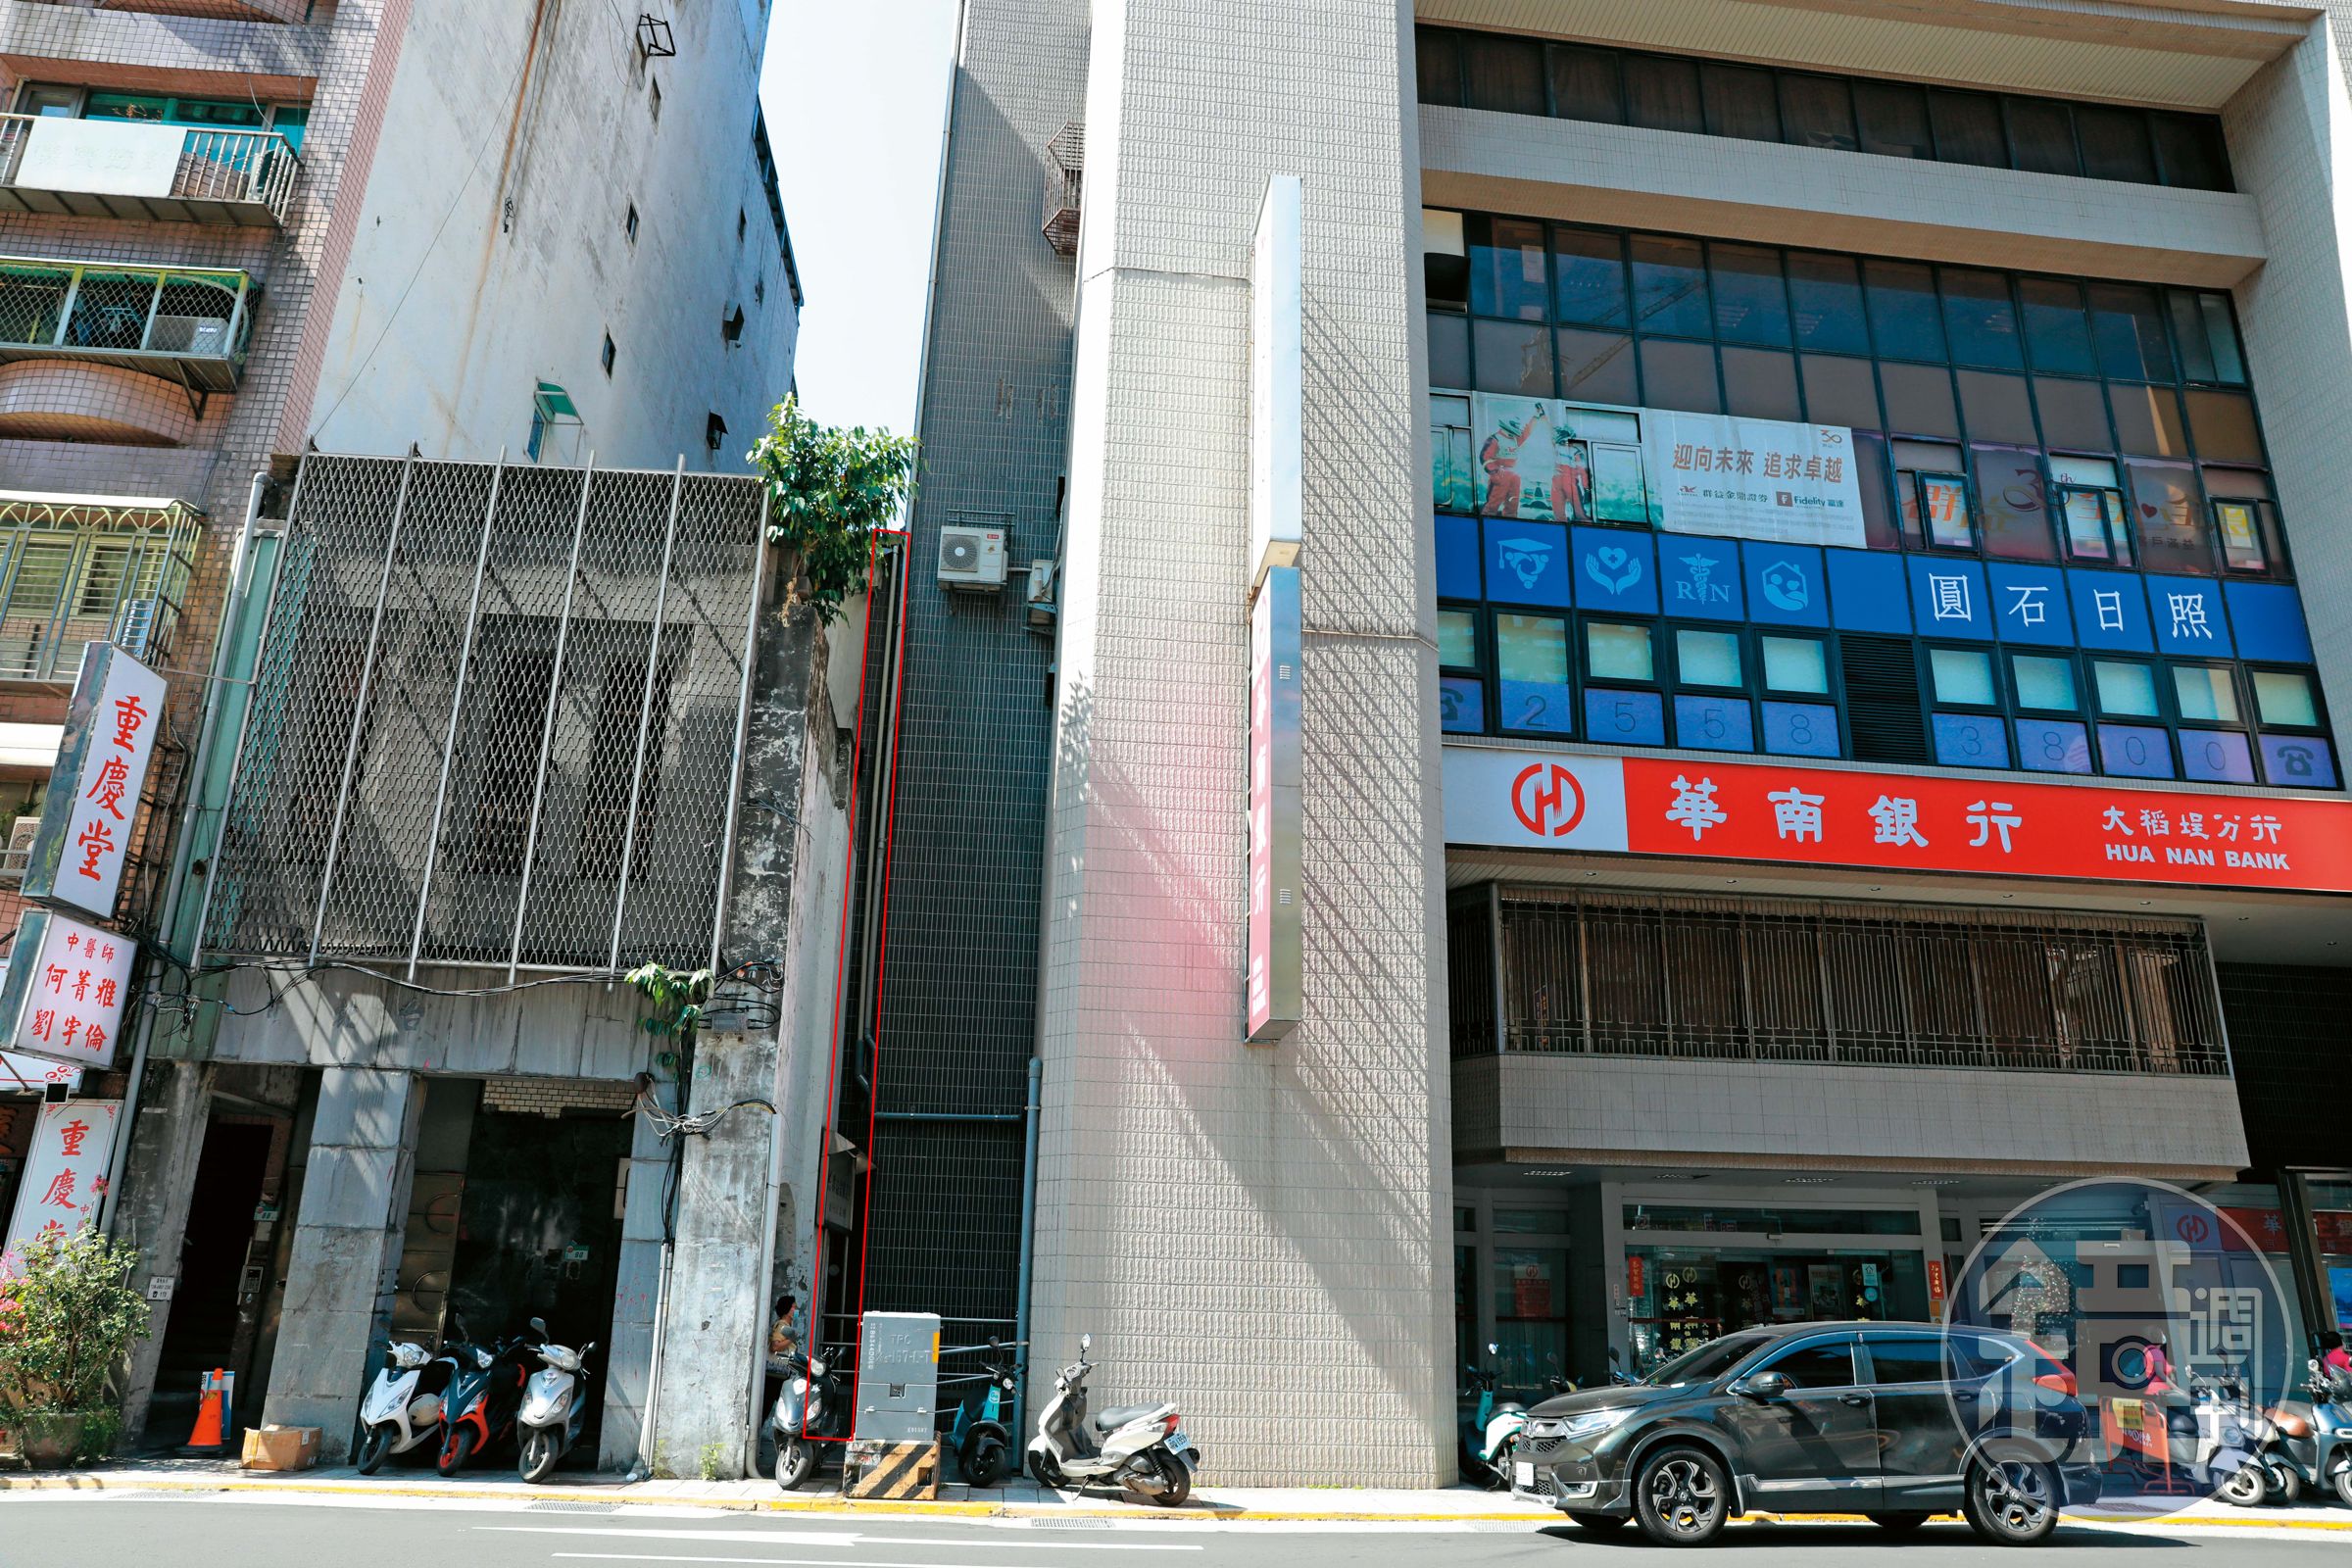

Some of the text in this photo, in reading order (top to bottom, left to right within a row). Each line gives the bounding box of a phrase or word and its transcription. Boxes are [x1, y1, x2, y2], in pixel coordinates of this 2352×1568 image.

[1673, 444, 1843, 483] 迎向未來 追求卓越
[1793, 495, 1826, 508] Fidelity
[1929, 572, 2213, 640] 圓石日照
[78, 696, 147, 881] 重慶堂
[1666, 774, 2022, 854] 華南銀行
[2102, 805, 2282, 845] 大稻埕分行
[2105, 844, 2289, 870] HUA NAN BANK
[68, 932, 115, 961] 中醫師
[46, 963, 116, 1008] 何菁雅
